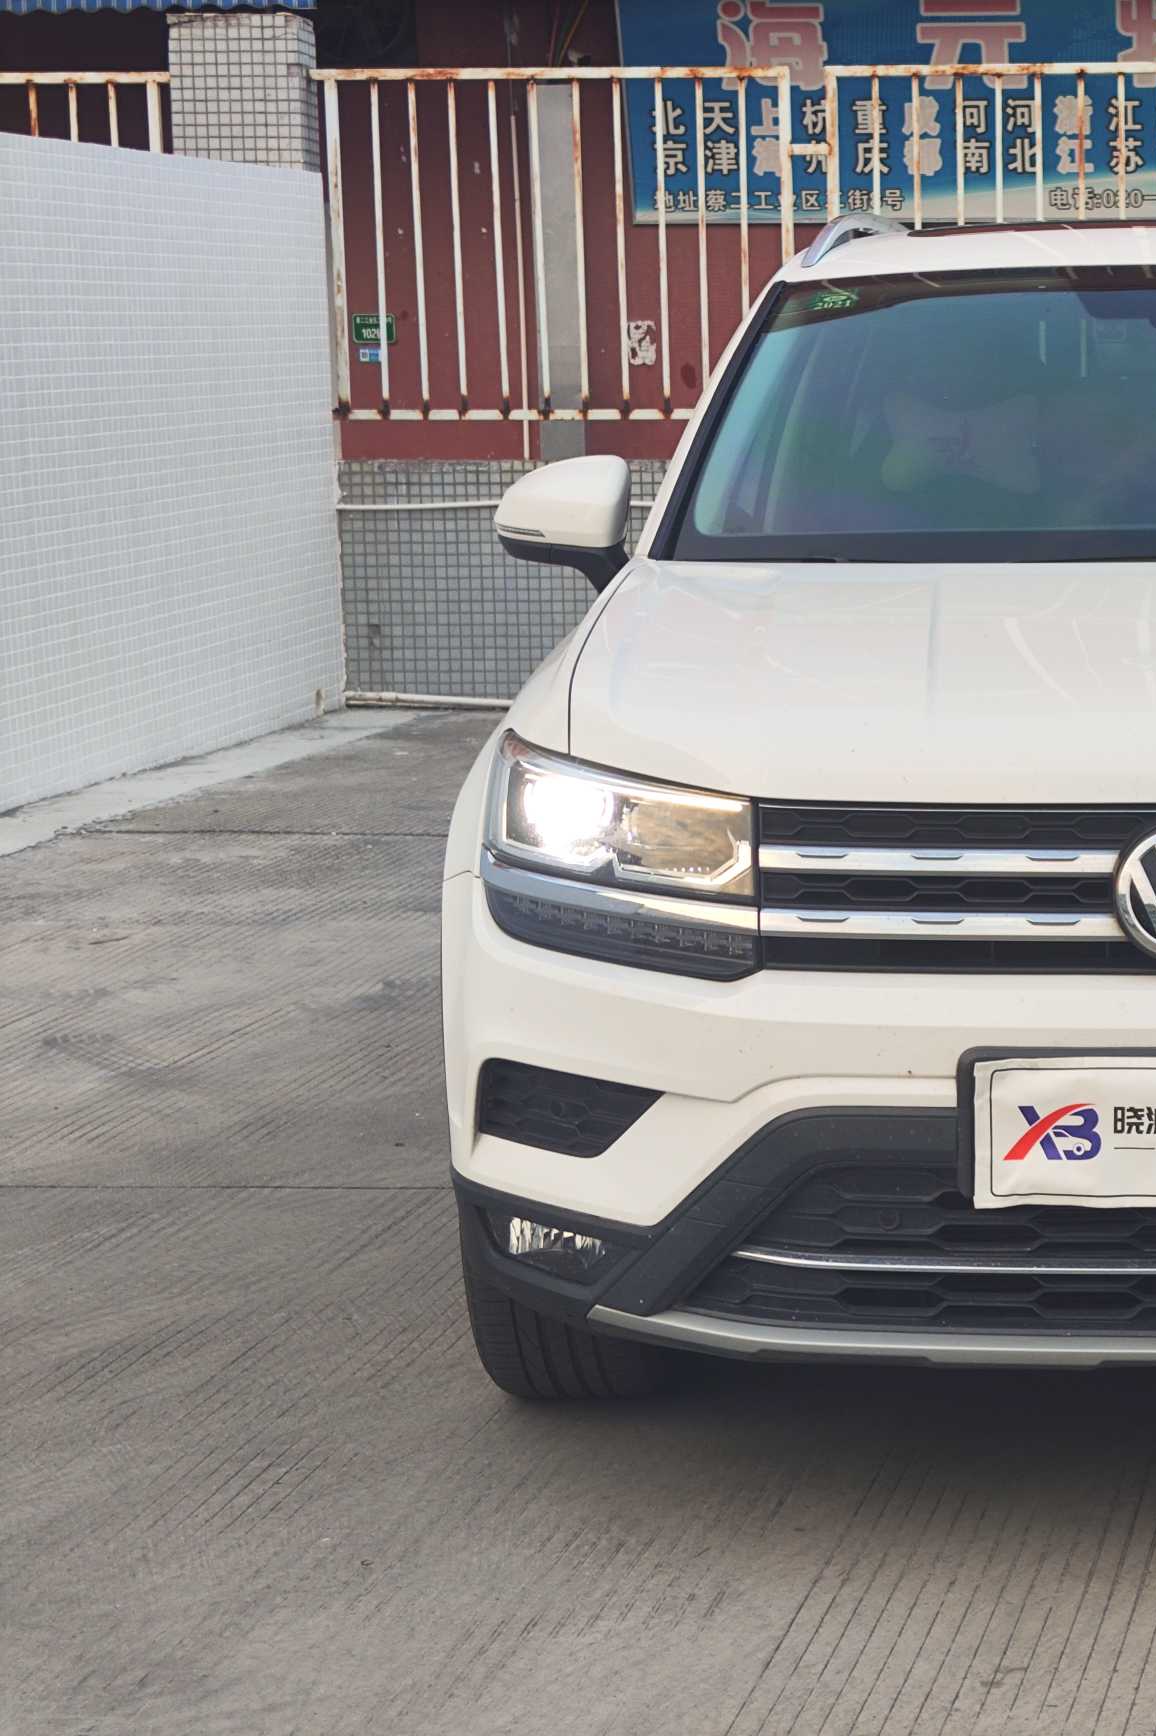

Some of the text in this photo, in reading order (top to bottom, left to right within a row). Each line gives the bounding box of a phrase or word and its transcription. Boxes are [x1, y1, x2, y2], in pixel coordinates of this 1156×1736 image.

[652, 100, 688, 175] 北京
[704, 101, 739, 175] 天津
[853, 98, 890, 174] 重庆
[1006, 99, 1040, 173] 河北
[1108, 98, 1144, 174] 江苏
